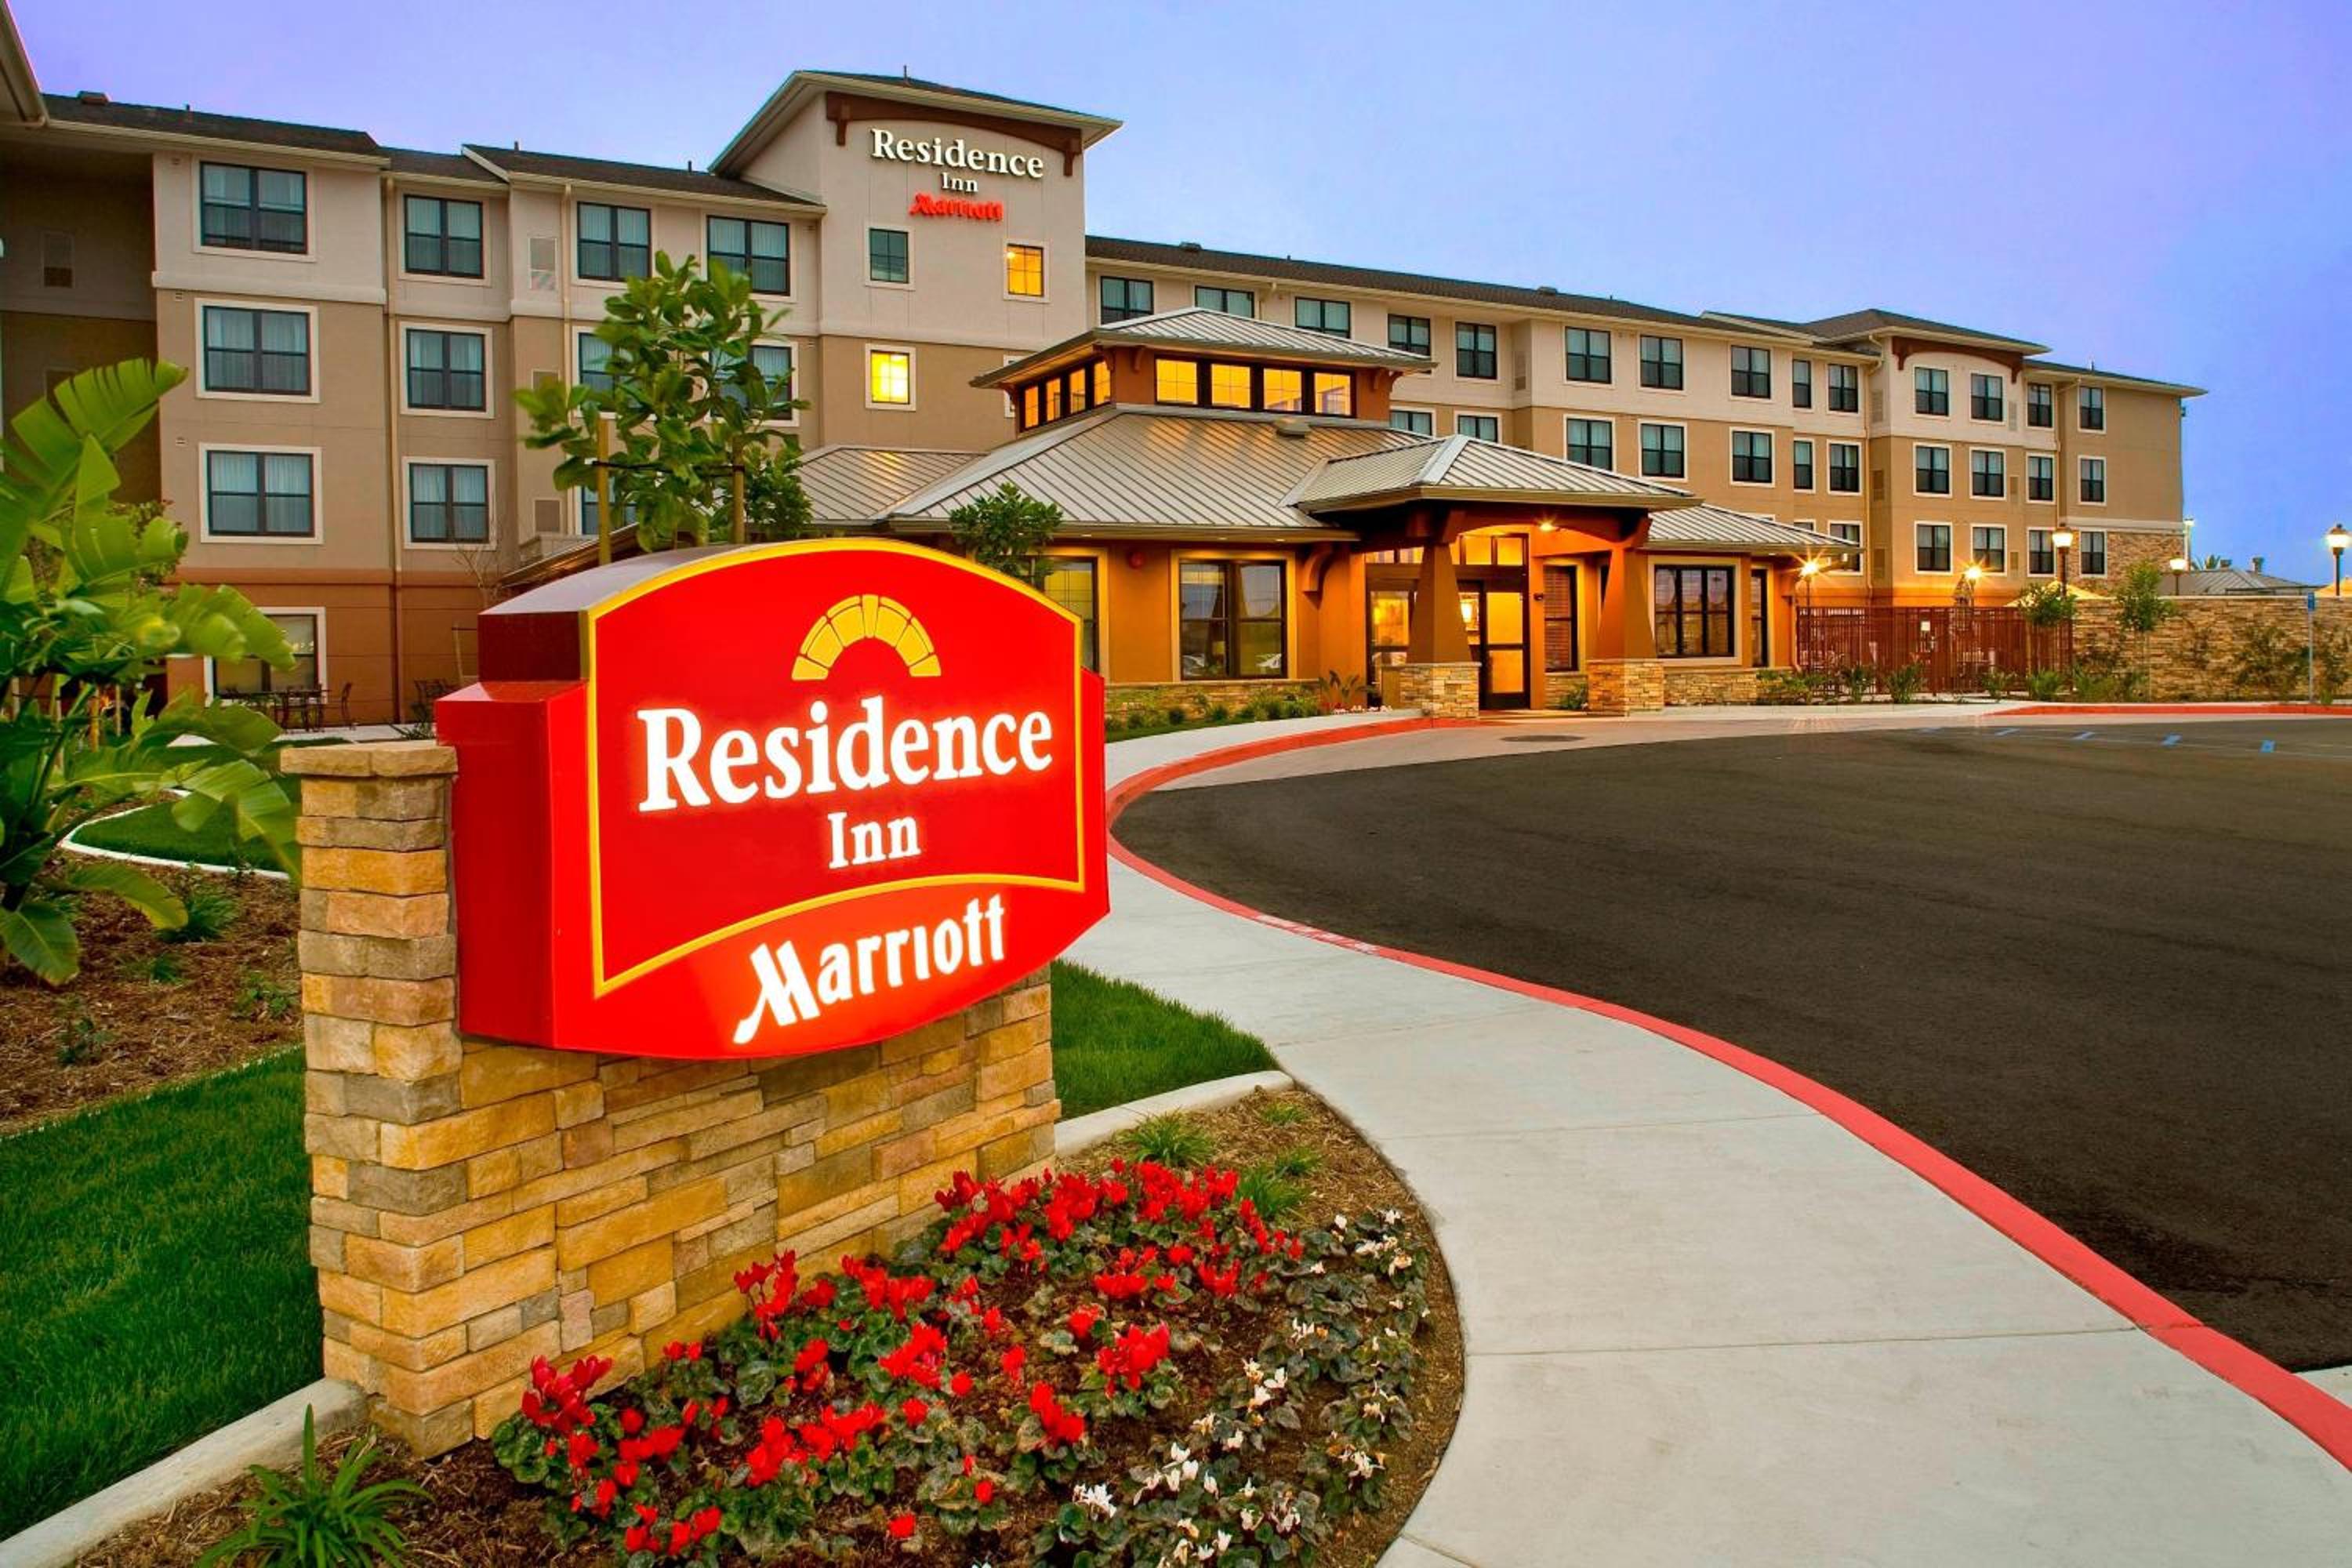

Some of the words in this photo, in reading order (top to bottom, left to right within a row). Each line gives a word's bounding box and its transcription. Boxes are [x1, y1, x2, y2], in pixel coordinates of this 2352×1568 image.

[871, 128, 1044, 179] Residence
[909, 193, 1003, 220] Marriott
[942, 172, 979, 193] Inn
[637, 695, 1053, 812] Residence
[827, 812, 920, 869] Inn
[732, 893, 1004, 1044] Marriott
